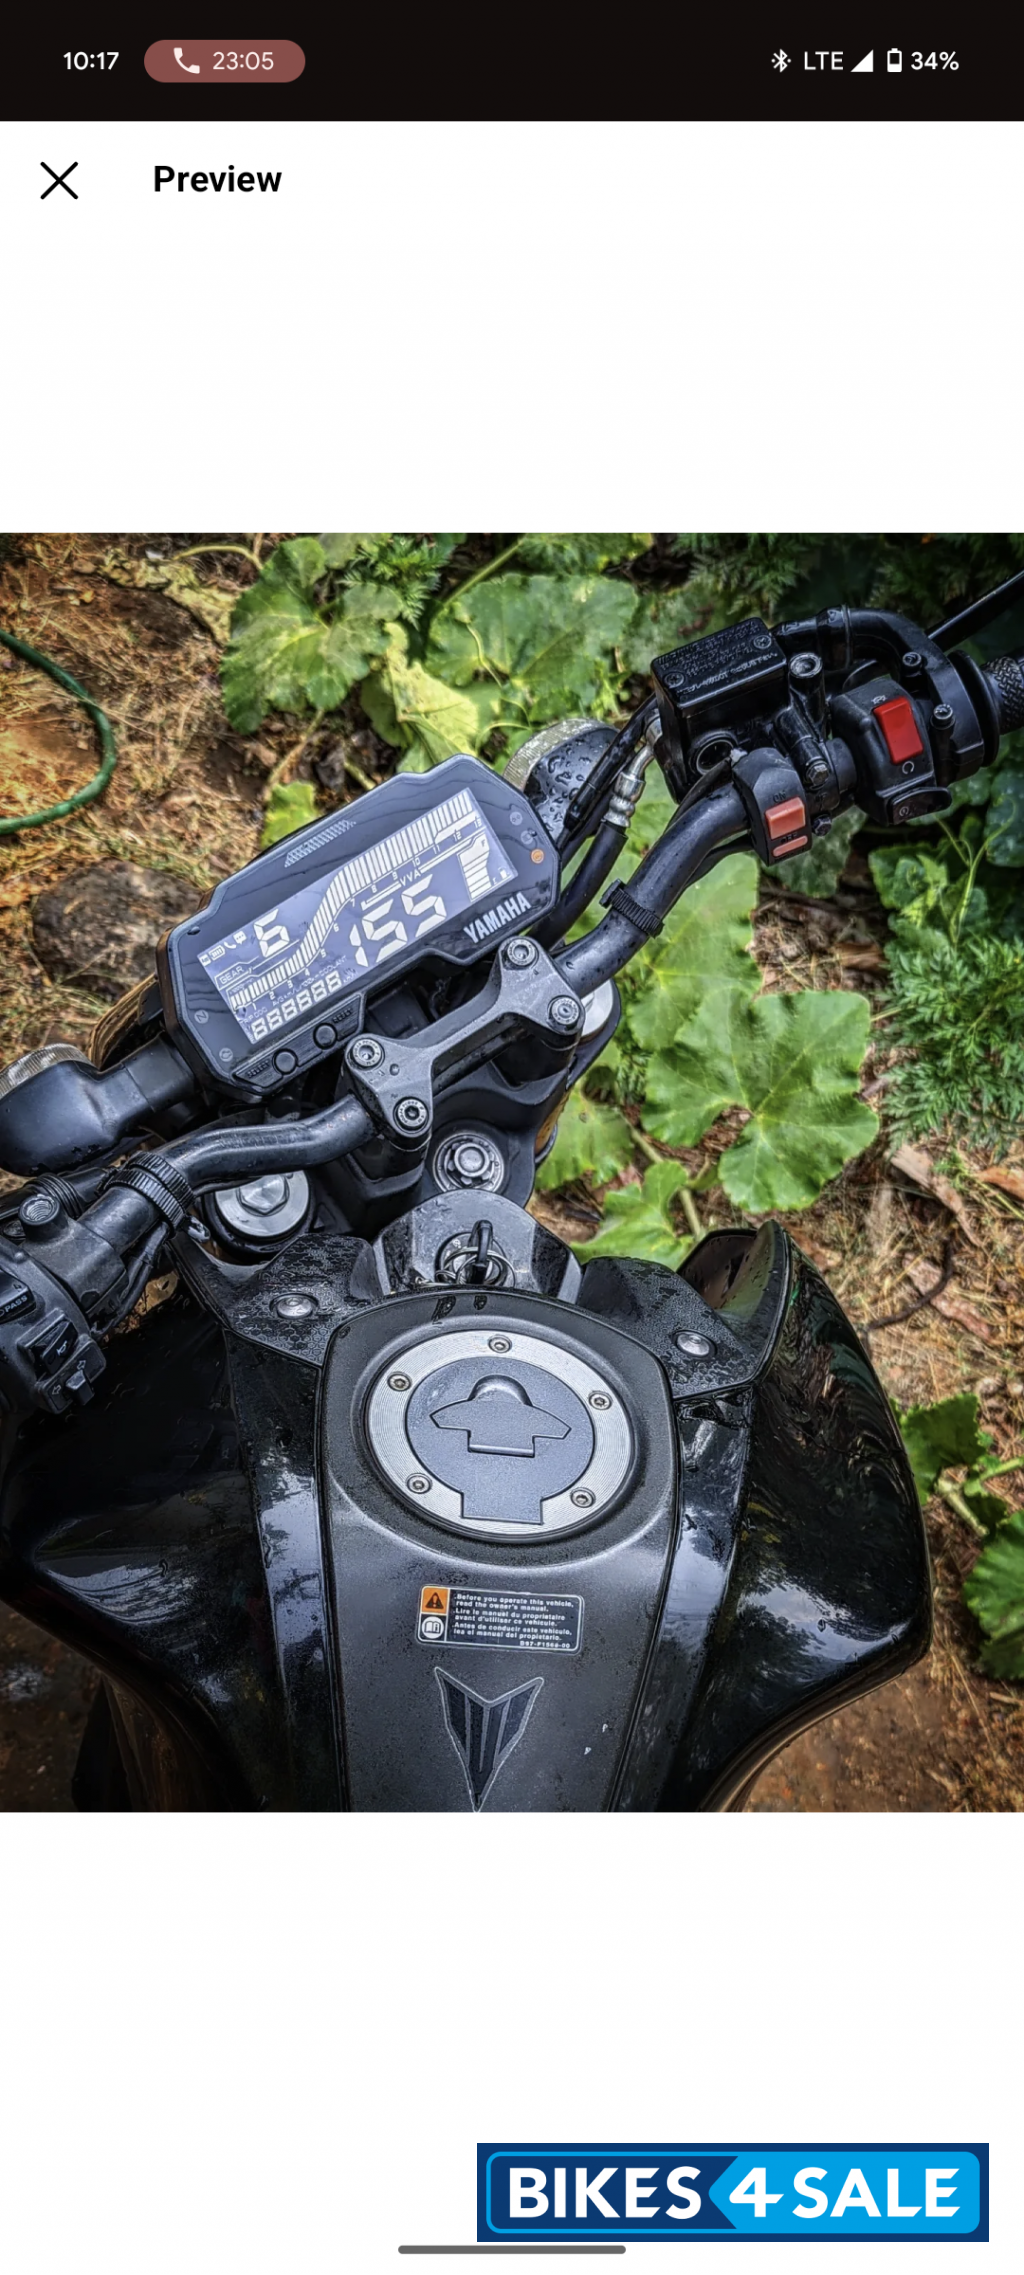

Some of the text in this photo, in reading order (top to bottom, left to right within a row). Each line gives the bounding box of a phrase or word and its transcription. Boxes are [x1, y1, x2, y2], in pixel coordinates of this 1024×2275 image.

[400, 869, 421, 887] VVA
[350, 874, 448, 967] 155
[464, 892, 532, 944] YAMAHA
[254, 908, 290, 958] 6
[220, 966, 244, 984] GEAR
[252, 970, 342, 1041] 888888
[4, 1295, 28, 1312] PASS
[500, 1597, 527, 1606] operate
[488, 1624, 520, 1632] conducir
